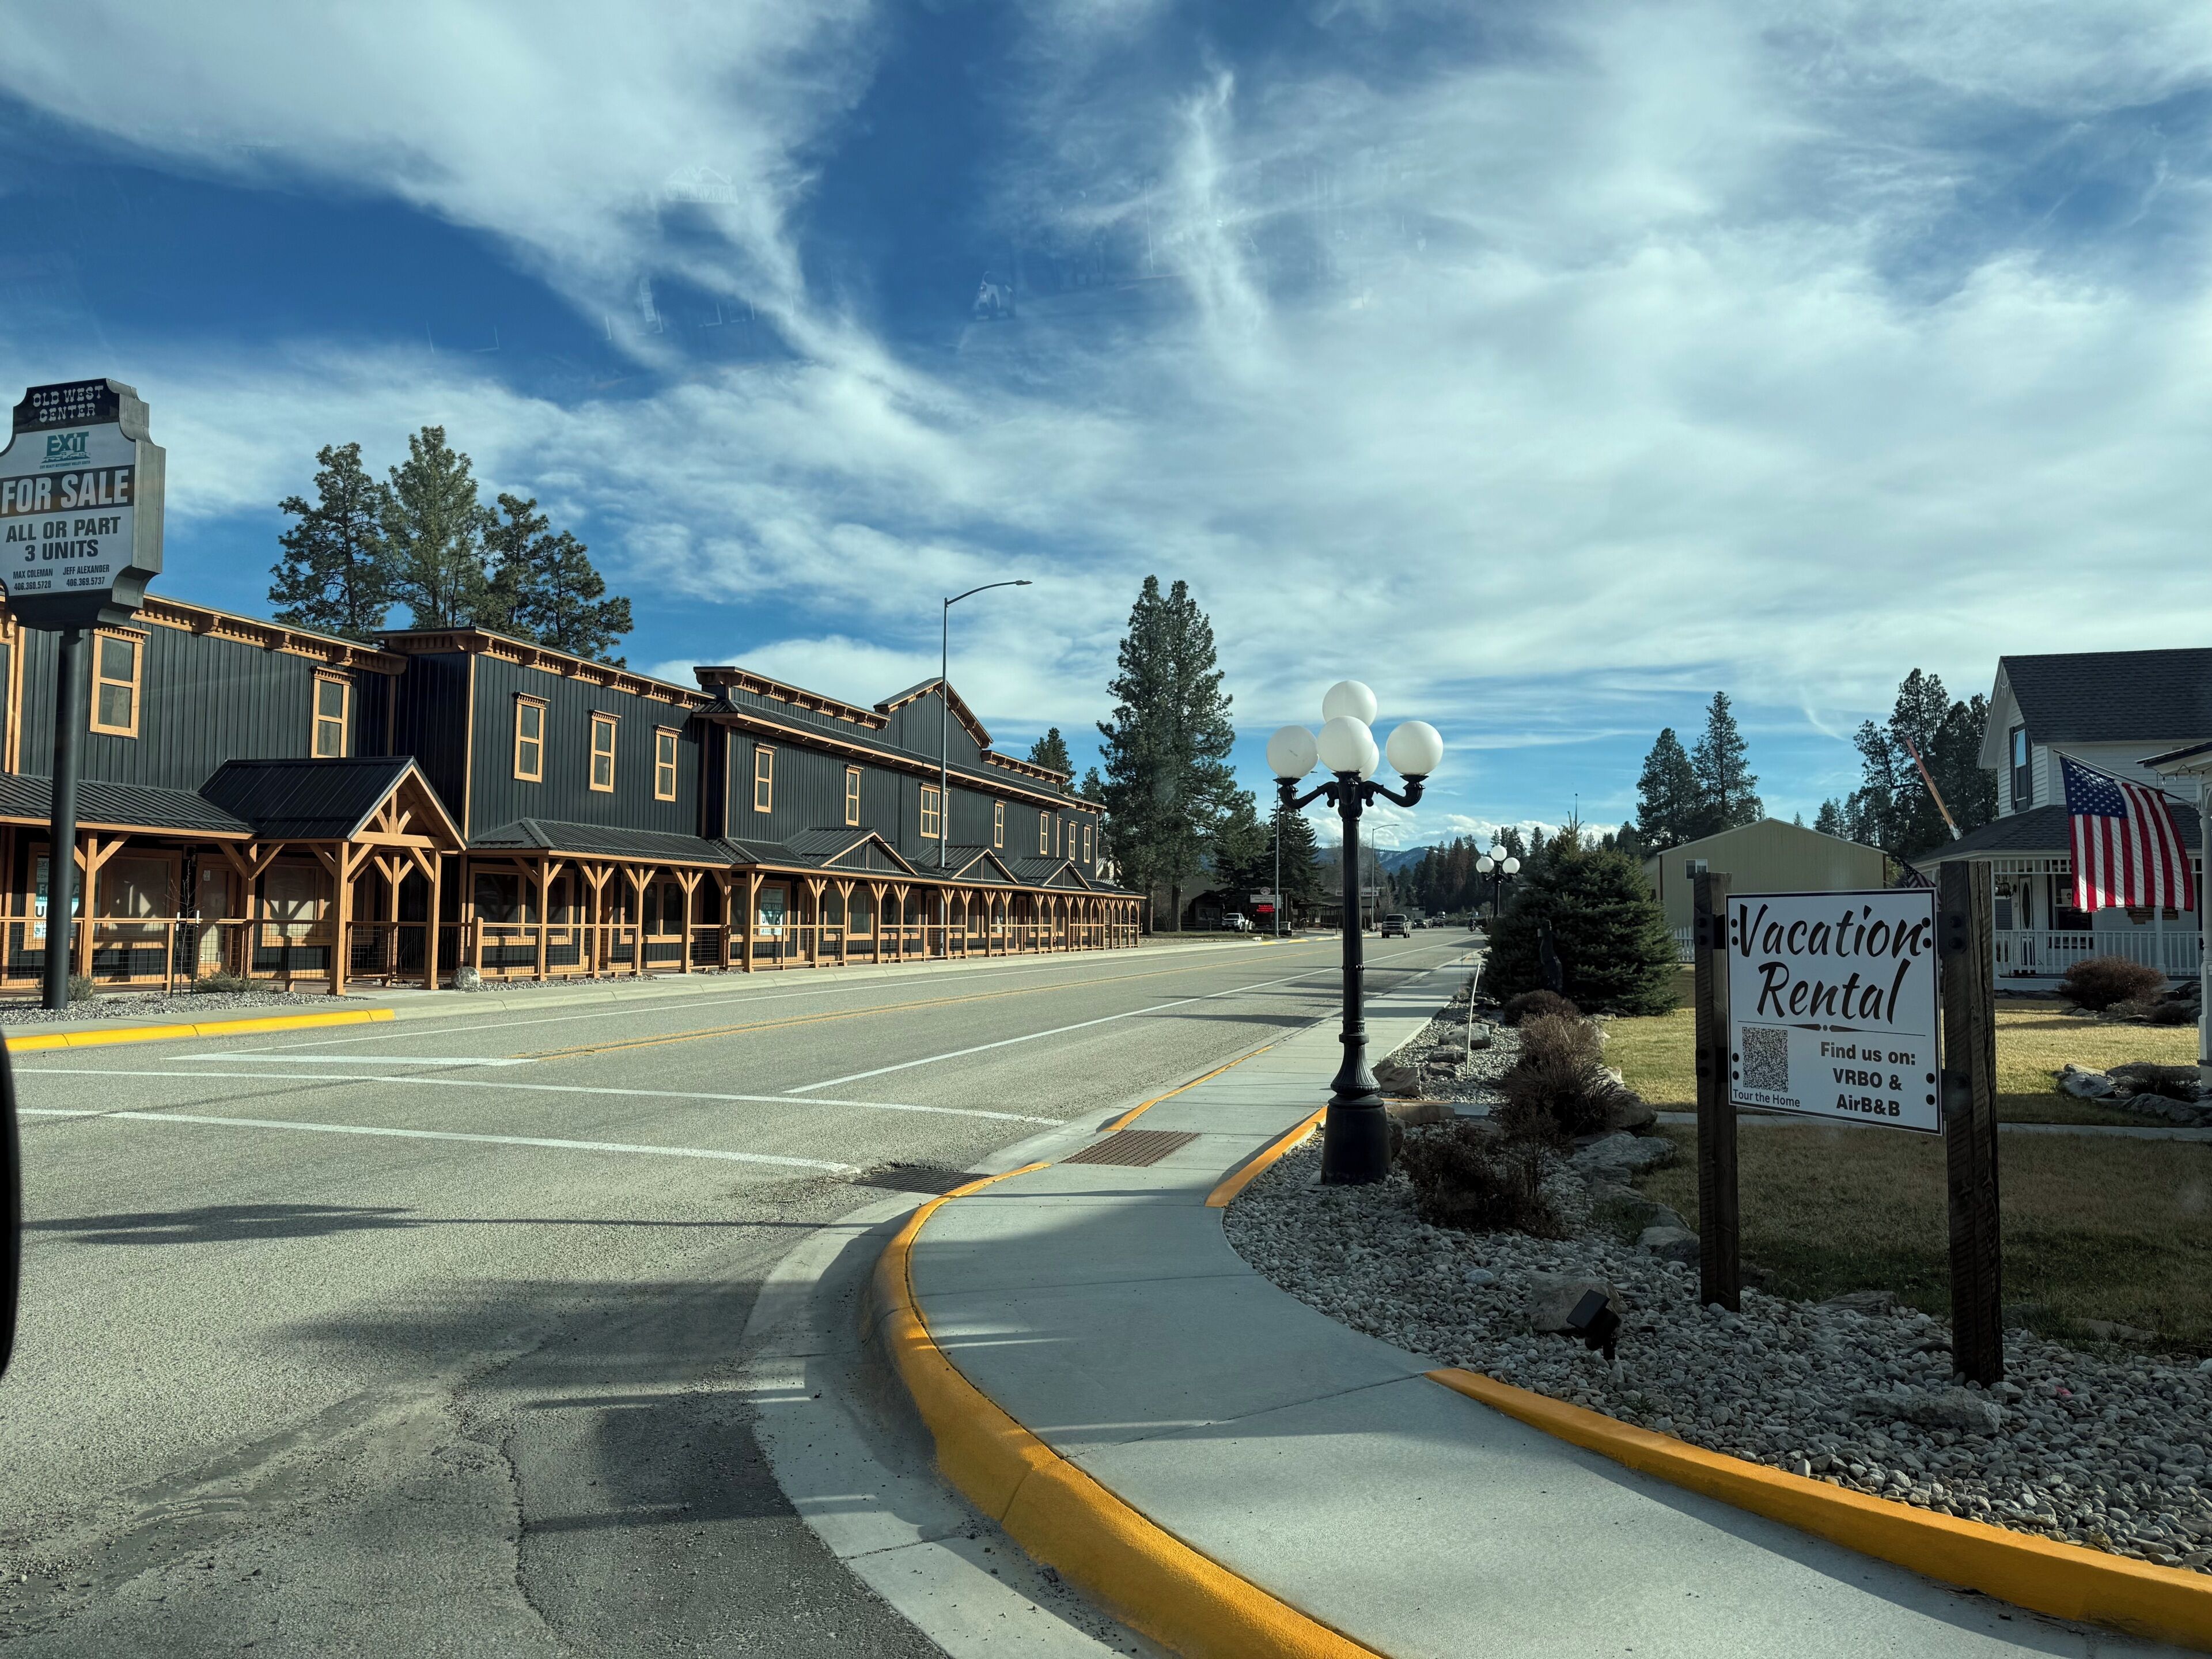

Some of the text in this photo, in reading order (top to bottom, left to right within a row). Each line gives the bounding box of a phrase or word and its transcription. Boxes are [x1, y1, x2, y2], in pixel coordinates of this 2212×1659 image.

[33, 385, 104, 407] OLD WEST
[39, 403, 96, 422] CENTER
[1, 469, 129, 514] FOR SALE
[6, 516, 121, 543] ALL OR PART
[25, 539, 99, 562] 3 UNITS
[13, 568, 53, 579] MAX COLEMAN
[63, 565, 109, 575] JEFF ALEXANDER
[66, 577, 105, 586] 406.369.5737
[1740, 903, 1925, 959] Vacation
[1757, 958, 1911, 1025] Rental
[1821, 1041, 1916, 1066] Find us on:
[1833, 1067, 1903, 1091] VRBO &
[1733, 1089, 1801, 1107] Tour the Home
[1836, 1094, 1901, 1117] AirB&B
